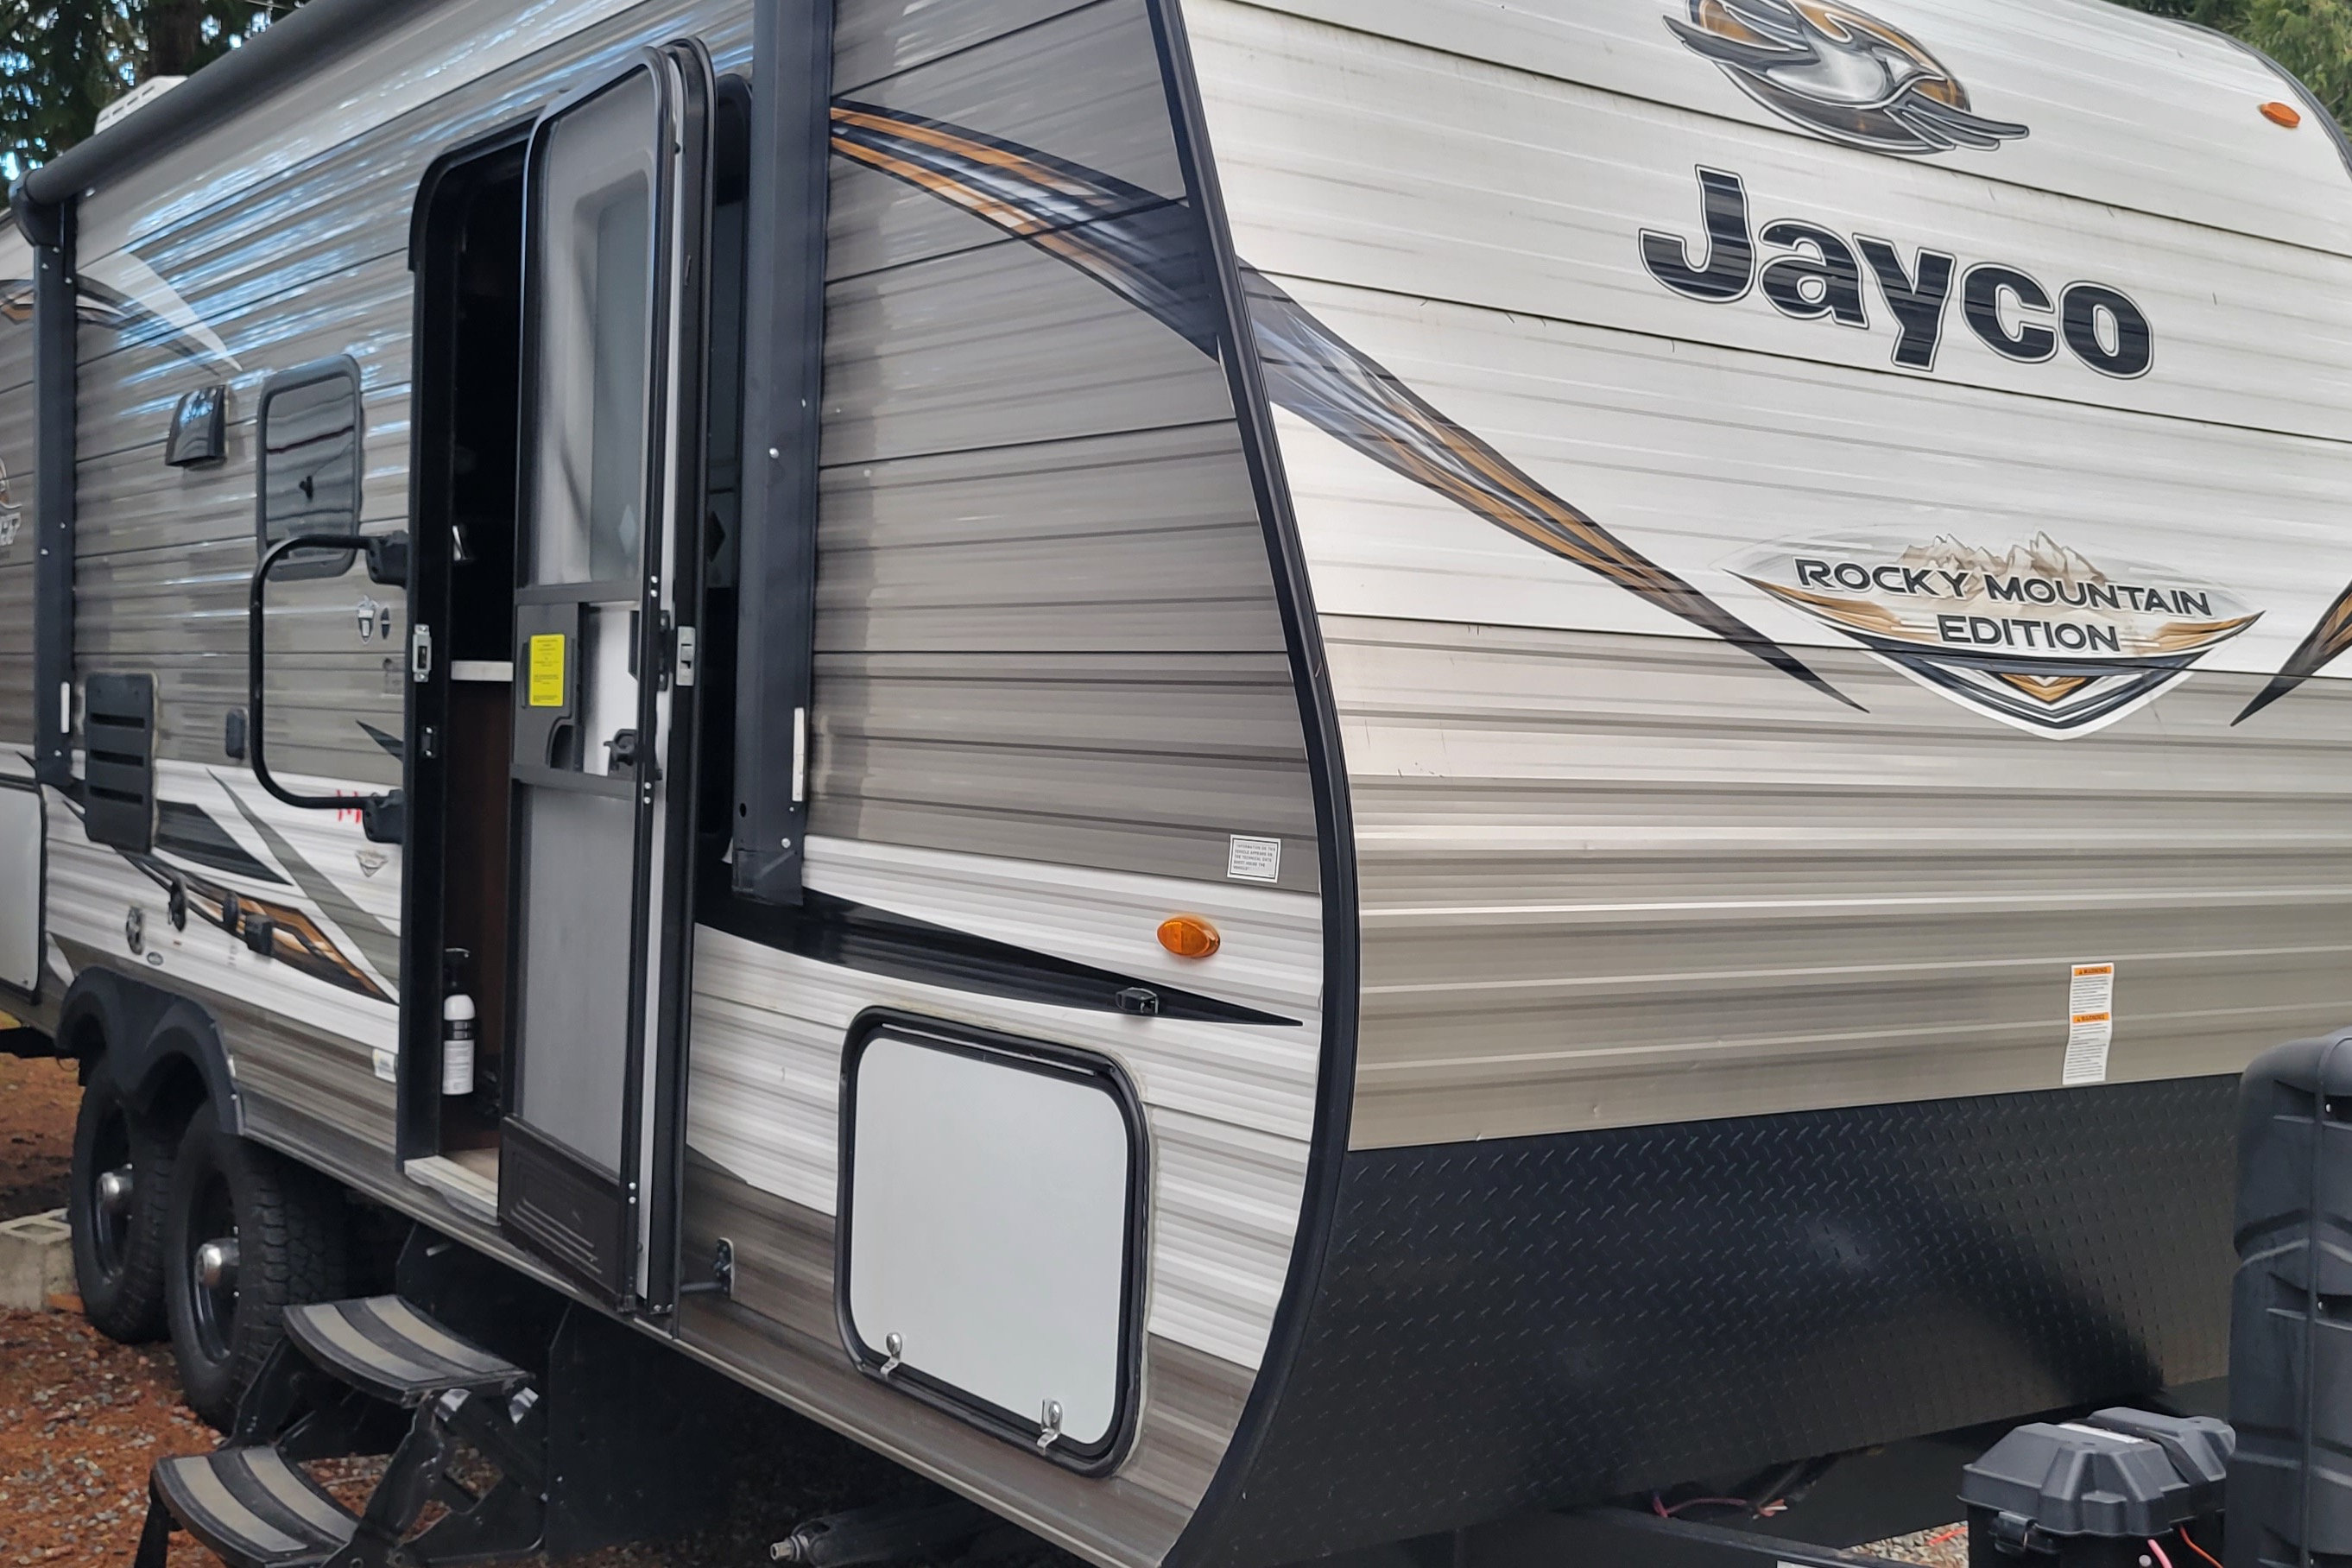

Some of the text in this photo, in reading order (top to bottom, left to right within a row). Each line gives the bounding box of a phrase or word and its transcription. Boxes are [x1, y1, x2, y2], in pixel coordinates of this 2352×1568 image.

[1639, 164, 2153, 380] Jayco
[1793, 558, 2213, 616] ROCKY MOUNTAIN
[1936, 614, 2121, 653] EDITION
